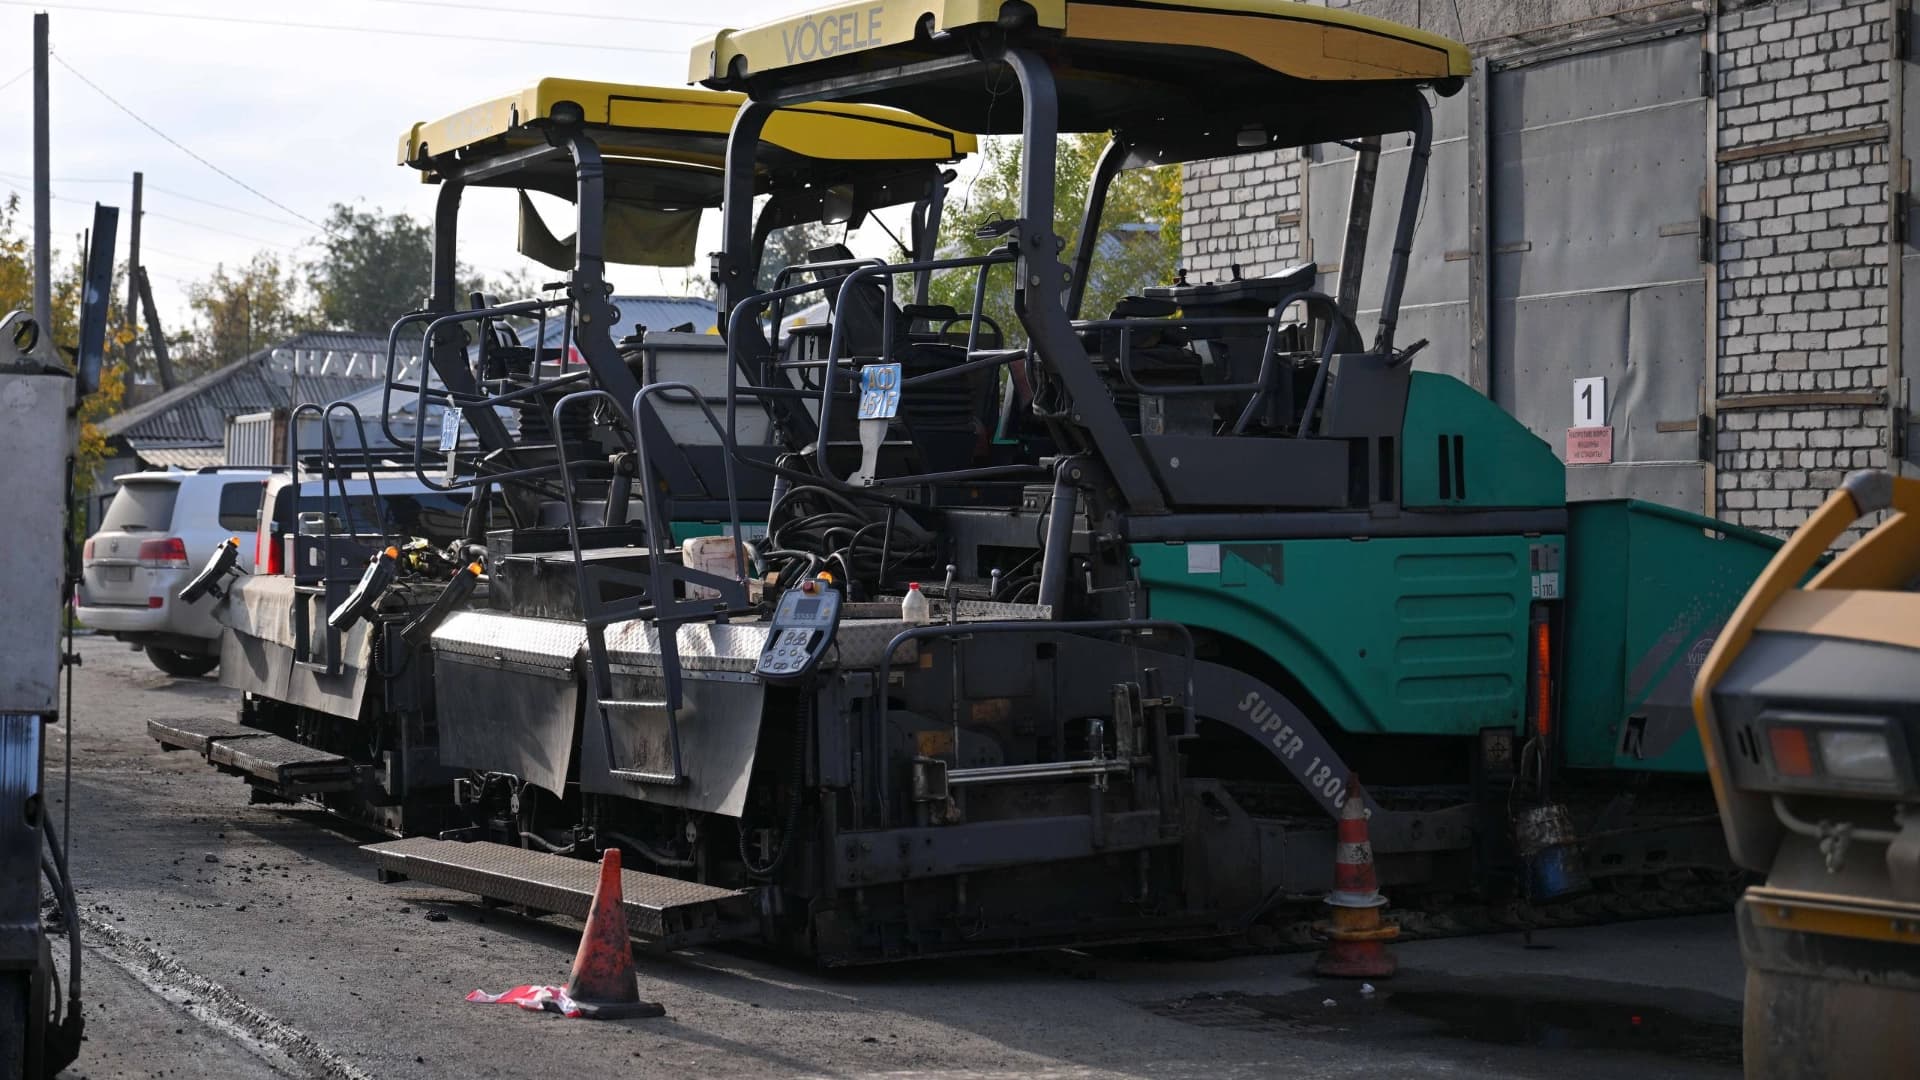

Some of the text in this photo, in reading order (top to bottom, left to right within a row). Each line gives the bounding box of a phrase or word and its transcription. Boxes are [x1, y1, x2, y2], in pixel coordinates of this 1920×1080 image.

[782, 6, 883, 64] VÖGELE
[271, 349, 421, 381] SHAANX
[1581, 384, 1592, 420] 1
[1238, 691, 1304, 759] SUPER
